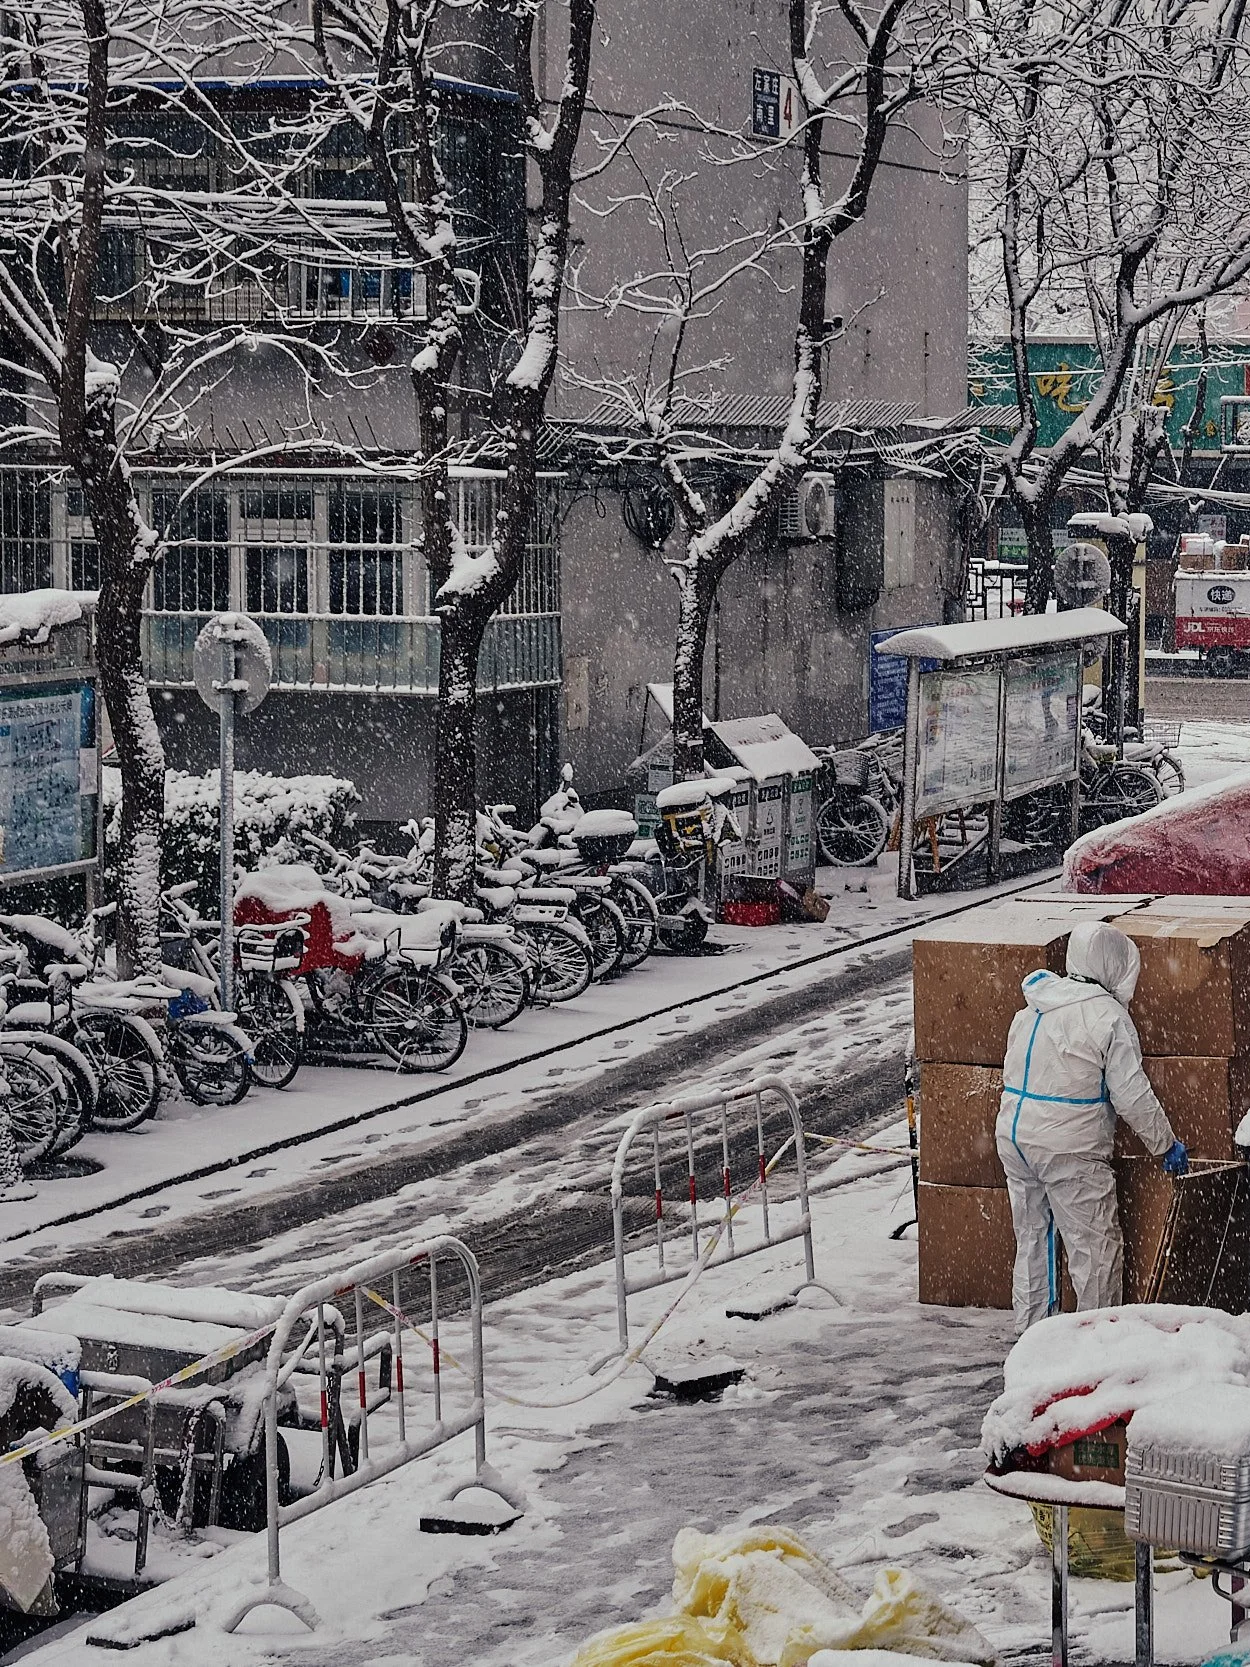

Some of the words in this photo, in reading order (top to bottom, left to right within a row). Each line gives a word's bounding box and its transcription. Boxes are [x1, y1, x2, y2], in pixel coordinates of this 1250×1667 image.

[754, 72, 779, 96] 左家庄
[783, 87, 793, 129] 4
[1210, 589, 1234, 601] 快递
[1183, 621, 1206, 633] JDL
